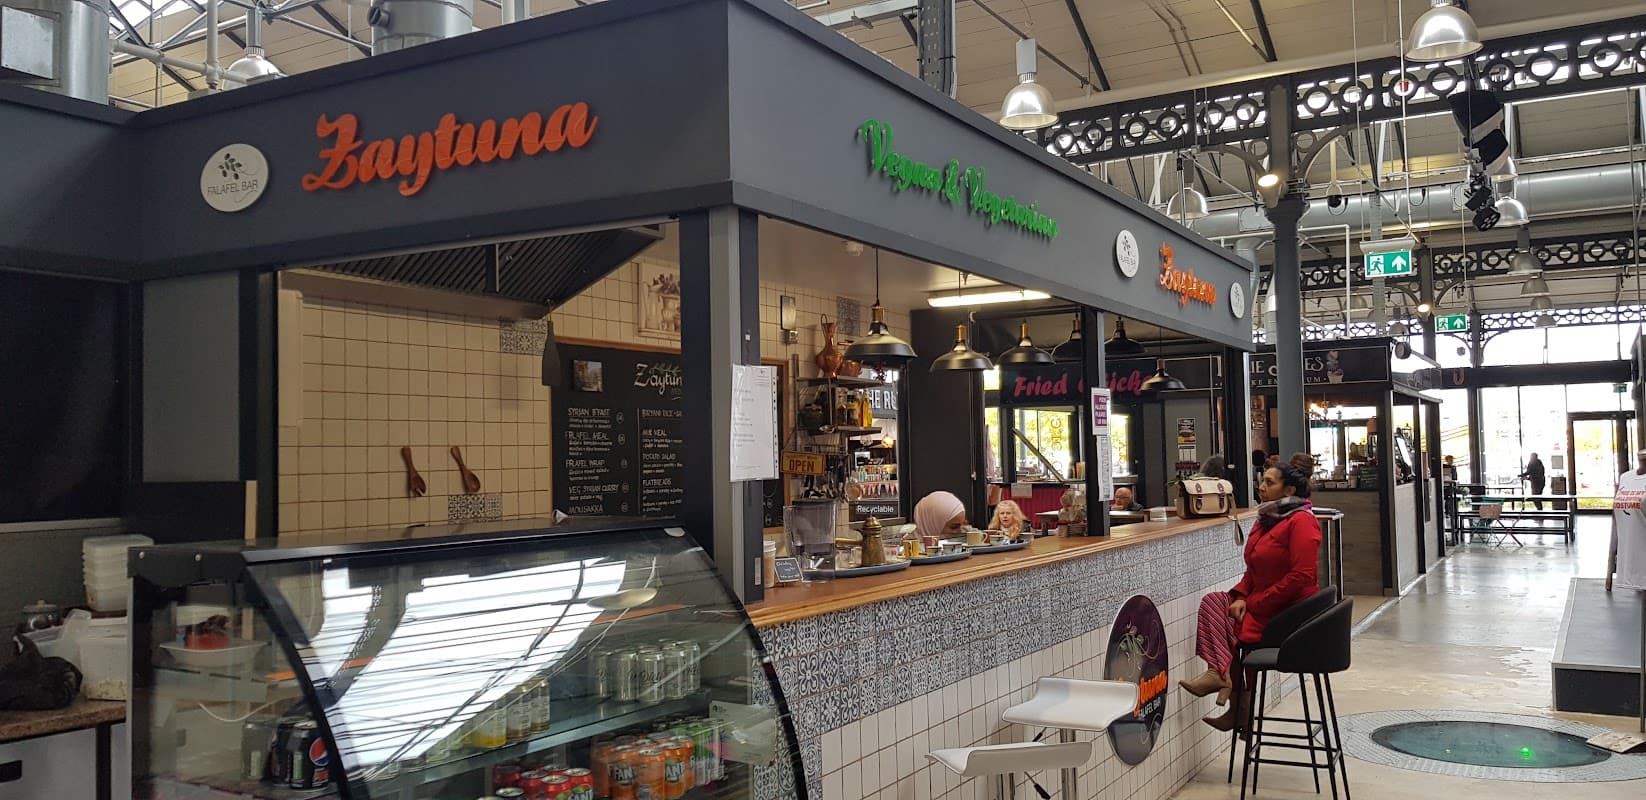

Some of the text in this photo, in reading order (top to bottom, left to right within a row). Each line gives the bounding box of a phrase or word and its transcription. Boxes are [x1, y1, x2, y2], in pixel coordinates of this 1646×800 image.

[302, 102, 598, 197] Zaytuna
[207, 179, 258, 196] FALAFEL BAR
[862, 118, 1058, 239] Vegan & Vegetarian
[1013, 372, 1069, 398] Fried
[789, 459, 815, 472] OPEN
[857, 504, 894, 514] Recyclable
